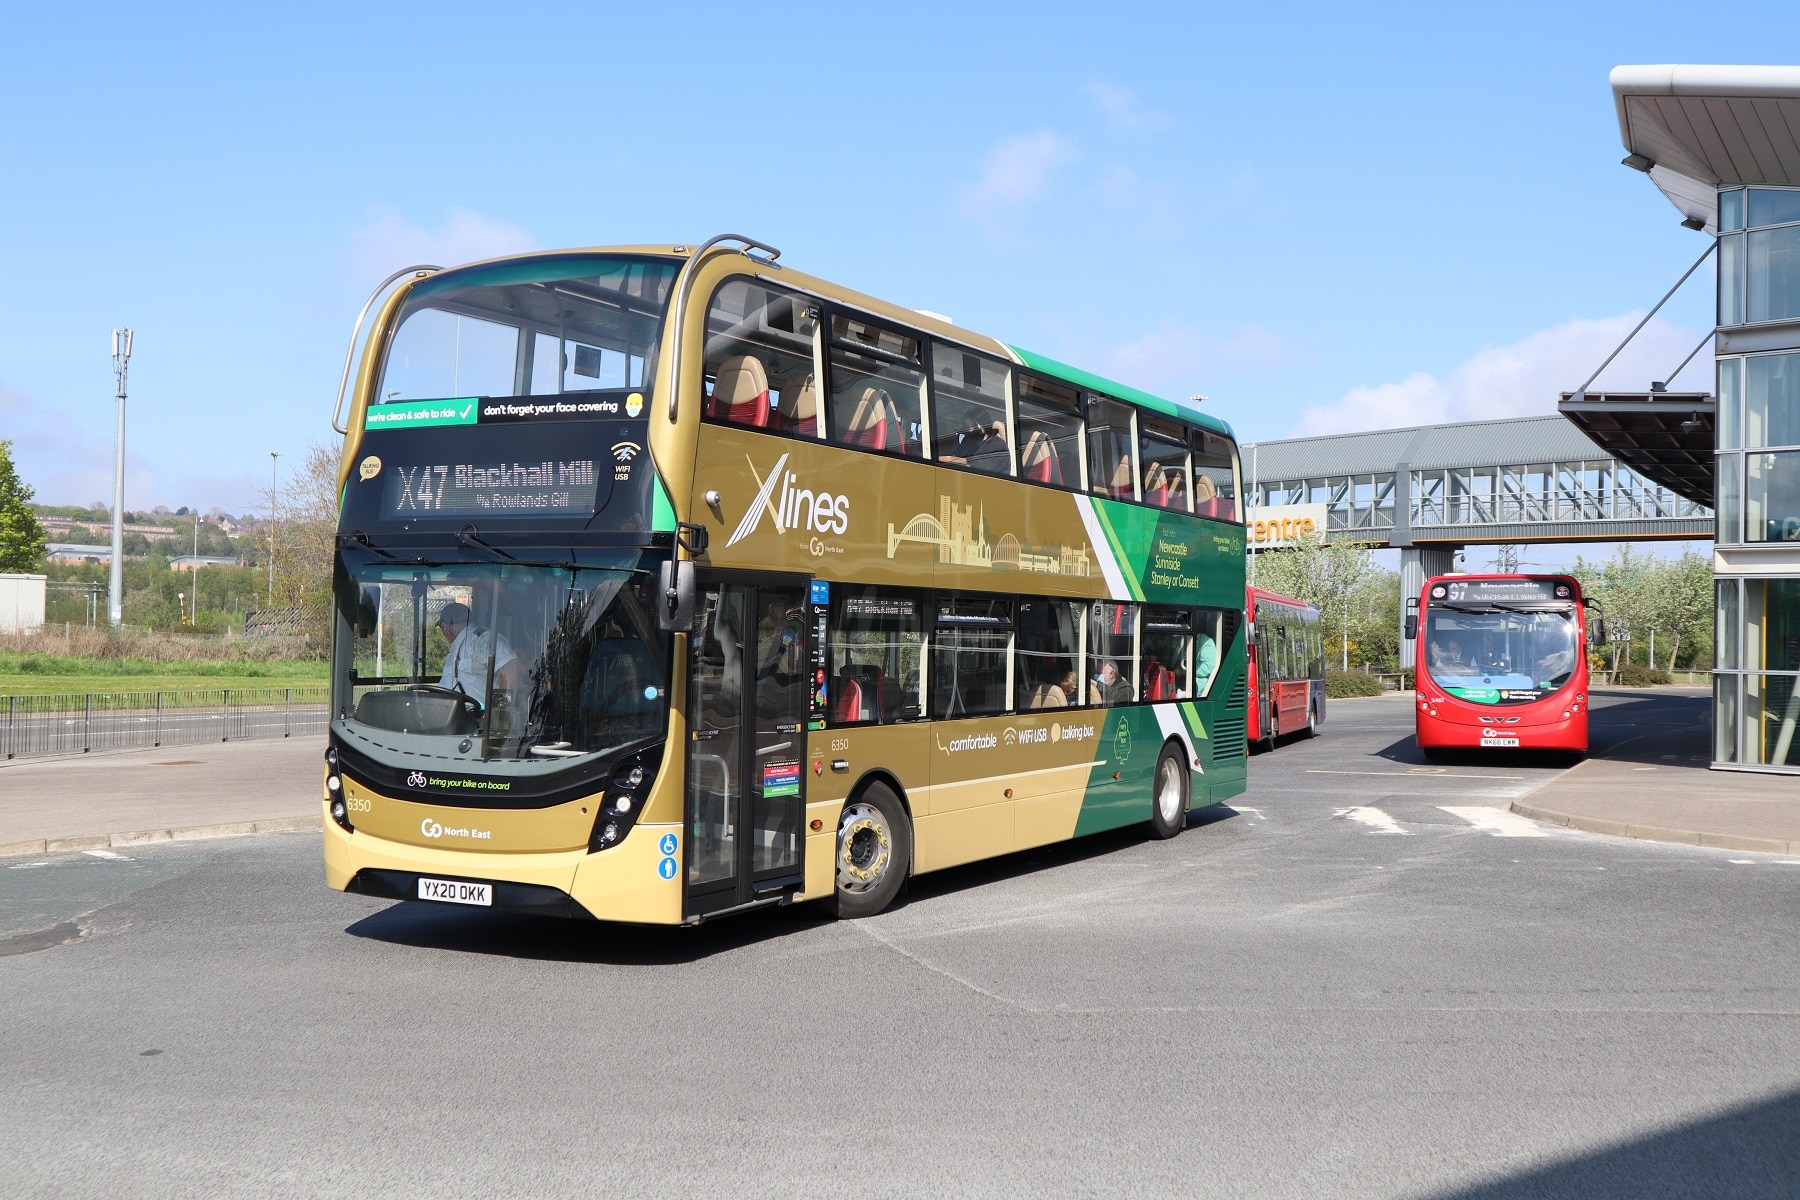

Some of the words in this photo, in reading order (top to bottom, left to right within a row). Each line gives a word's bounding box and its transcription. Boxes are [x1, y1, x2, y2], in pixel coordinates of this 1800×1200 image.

[367, 412, 386, 423] we're
[386, 411, 407, 422] clean
[406, 410, 413, 420] &
[413, 409, 430, 419] safe
[430, 410, 440, 419] to
[439, 408, 456, 418] ride
[484, 405, 507, 416] don't
[507, 404, 535, 417] forget
[534, 404, 556, 416] your
[555, 402, 577, 413] face
[577, 401, 619, 414] covering
[614, 473, 629, 481] USB
[615, 465, 631, 473] WIFI
[397, 465, 448, 510] X47
[455, 461, 553, 488] Blackhall
[559, 460, 593, 486] Mill
[492, 493, 549, 508] Rowlands
[551, 492, 569, 507] Gill
[1159, 539, 1188, 556] Newcastle
[1155, 555, 1181, 571] Sunniside
[1151, 570, 1172, 589] Stanley
[1172, 576, 1179, 587] or
[1178, 574, 1200, 589] Consett
[1018, 728, 1034, 745] WiFi
[1034, 728, 1048, 743] USB
[1061, 725, 1083, 742] talking
[1083, 724, 1095, 737] bus
[831, 738, 849, 751] 6350
[950, 733, 997, 752] comfortable
[429, 777, 447, 788] bring
[446, 779, 462, 788] your
[462, 780, 477, 789] bike
[487, 781, 511, 791] board
[347, 798, 371, 813] 6350
[421, 818, 442, 838] Go
[444, 826, 469, 838] North
[471, 828, 491, 840] East
[424, 881, 456, 899] YX20
[459, 884, 486, 902] OKK
